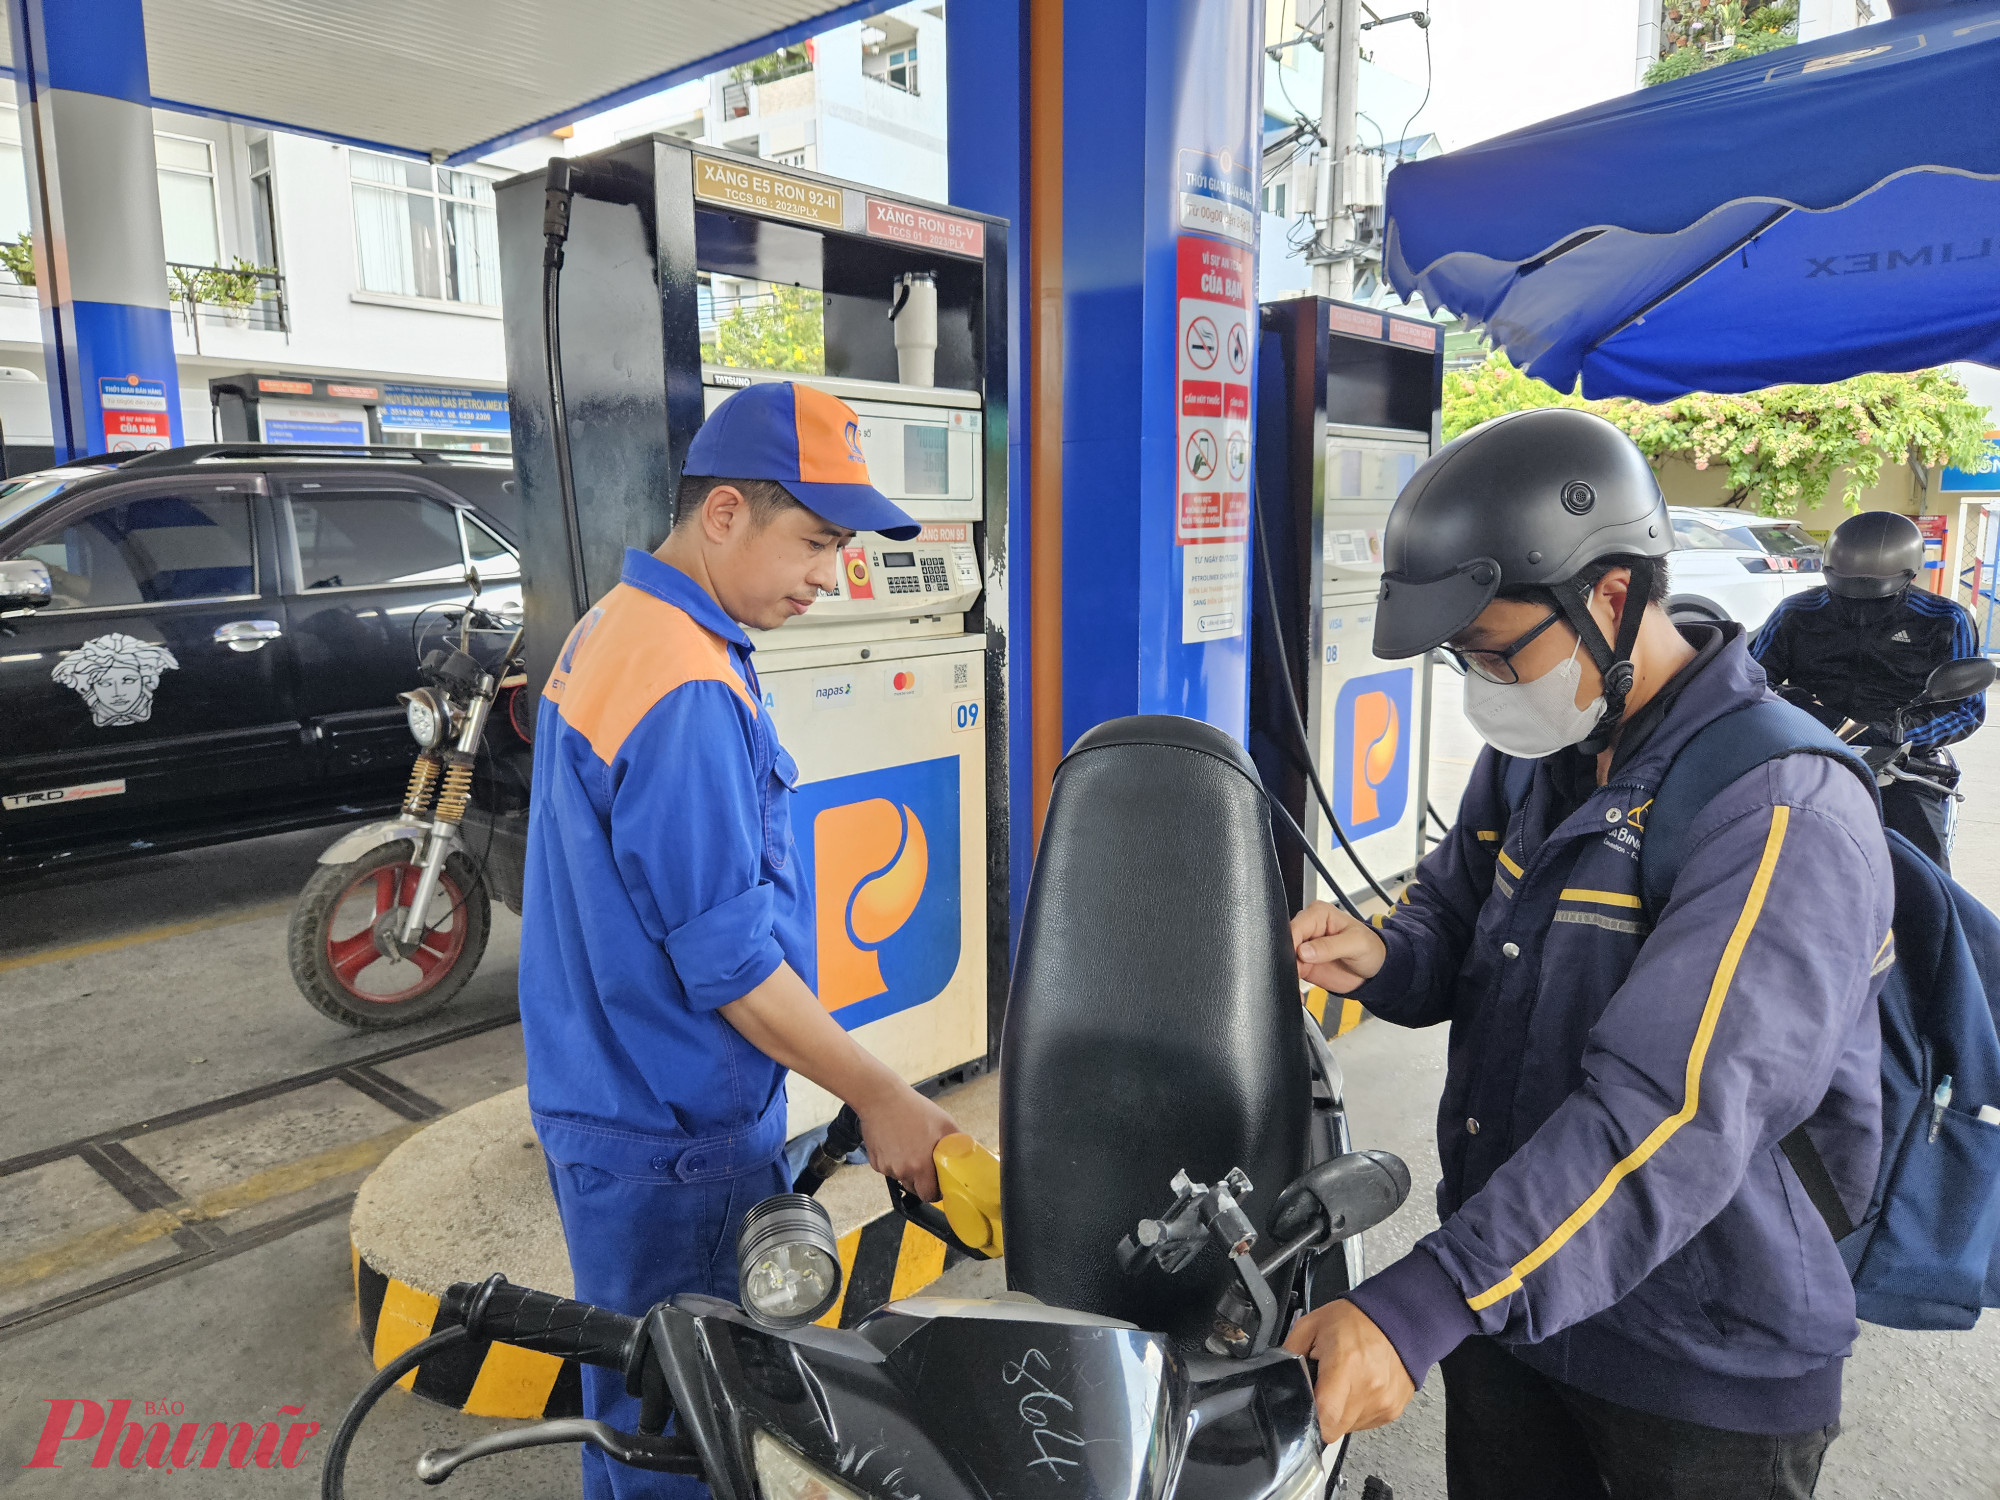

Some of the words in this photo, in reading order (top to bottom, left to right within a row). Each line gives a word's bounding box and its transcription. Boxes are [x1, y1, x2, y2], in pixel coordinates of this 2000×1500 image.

[705, 165, 748, 188] XĂNG
[753, 177, 770, 193] E5
[775, 182, 805, 200] RON
[808, 191, 835, 209] 92-II
[724, 188, 753, 202] TCCS
[756, 196, 767, 206] 06
[775, 200, 818, 218] 2023/PLX
[877, 206, 914, 227] XĂNG
[918, 216, 945, 234] RON
[948, 224, 974, 240] 95-V
[888, 225, 911, 239] TCCS
[913, 231, 922, 240] 01
[930, 234, 965, 250] 2023/PLX
[1201, 269, 1223, 295] CỦA
[1225, 278, 1243, 302] BẠN
[715, 375, 750, 387] TATSUNO
[413, 395, 440, 407] DOANH
[441, 397, 457, 409] GAS
[459, 398, 502, 411] PETROLIMEX
[120, 422, 138, 433] CỦA
[140, 424, 157, 434] BẠN
[941, 528, 955, 540] RON
[956, 528, 964, 540] 95
[1326, 645, 1337, 662] 08
[816, 686, 844, 699] napas
[957, 703, 978, 728] 09
[8, 790, 64, 805] TRD
